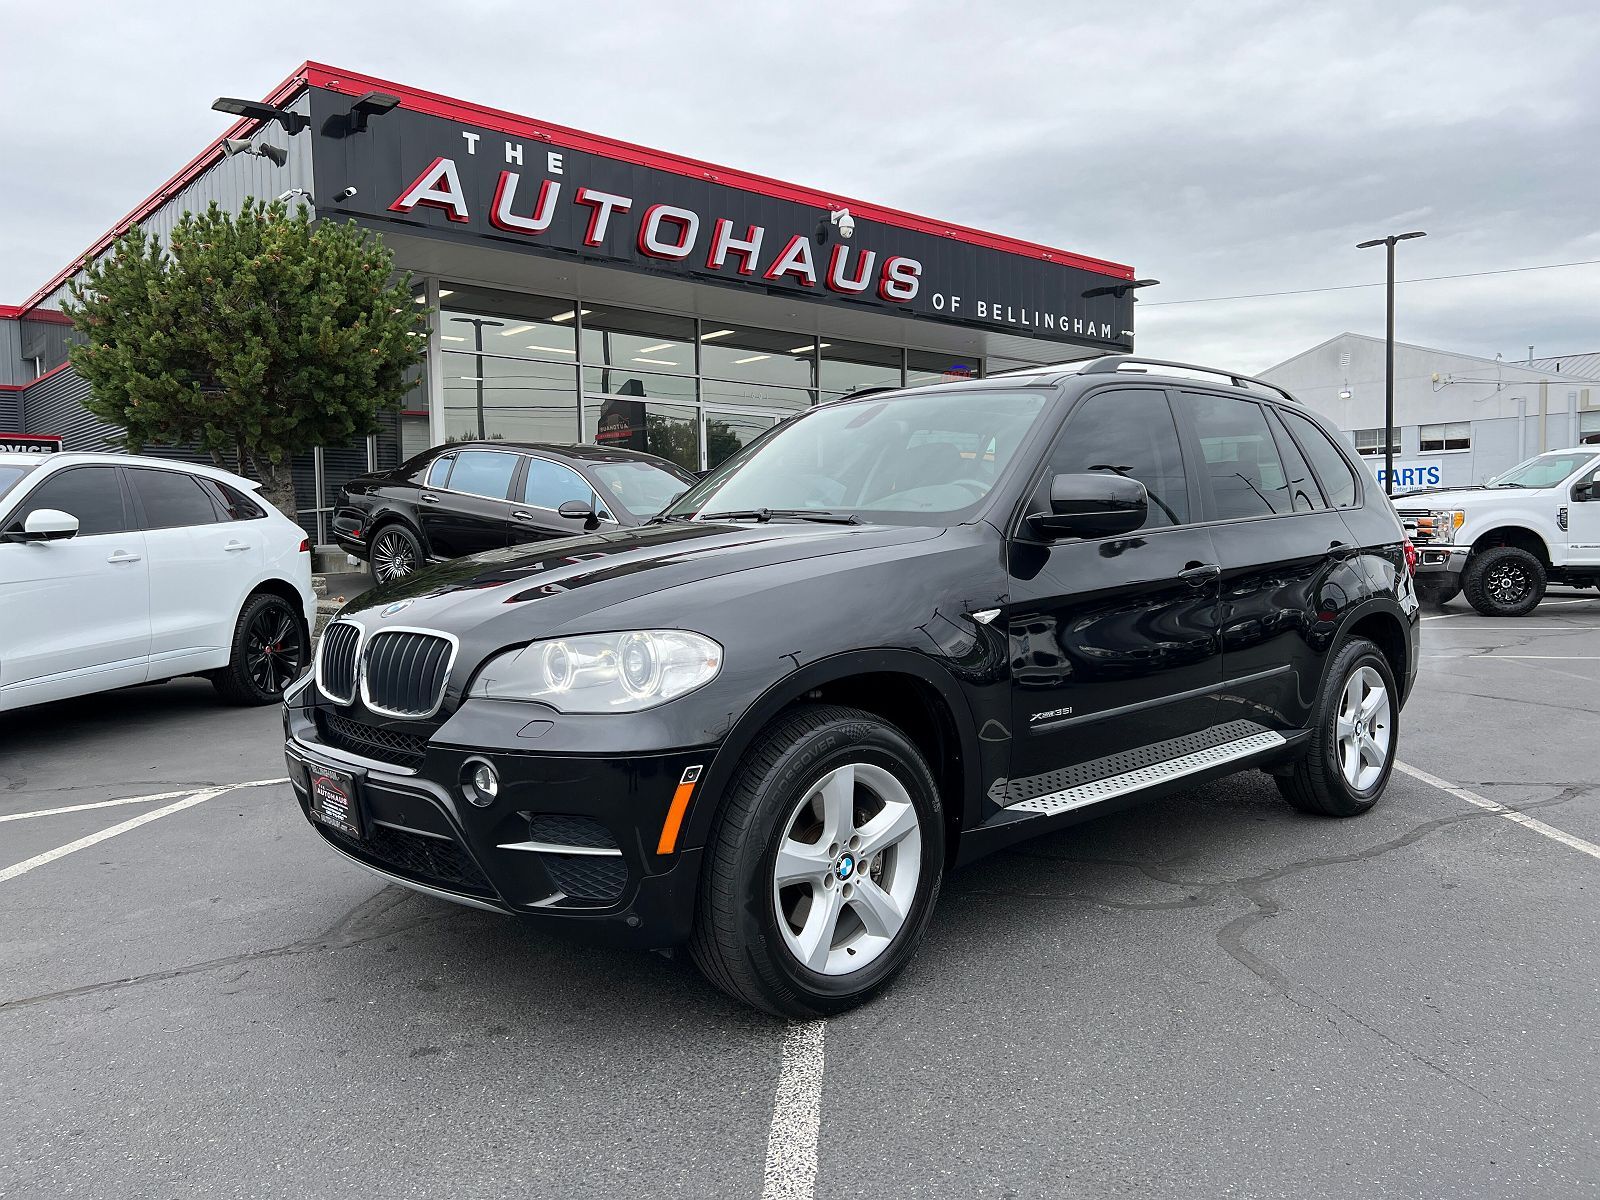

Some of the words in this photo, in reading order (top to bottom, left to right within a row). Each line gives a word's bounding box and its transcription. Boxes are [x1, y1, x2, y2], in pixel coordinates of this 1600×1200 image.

[462, 131, 563, 175] THE
[387, 156, 923, 303] AUTOHAUS
[932, 293, 961, 313] OF
[977, 301, 1111, 339] BELLINGHAM
[1377, 466, 1440, 486] PARTS
